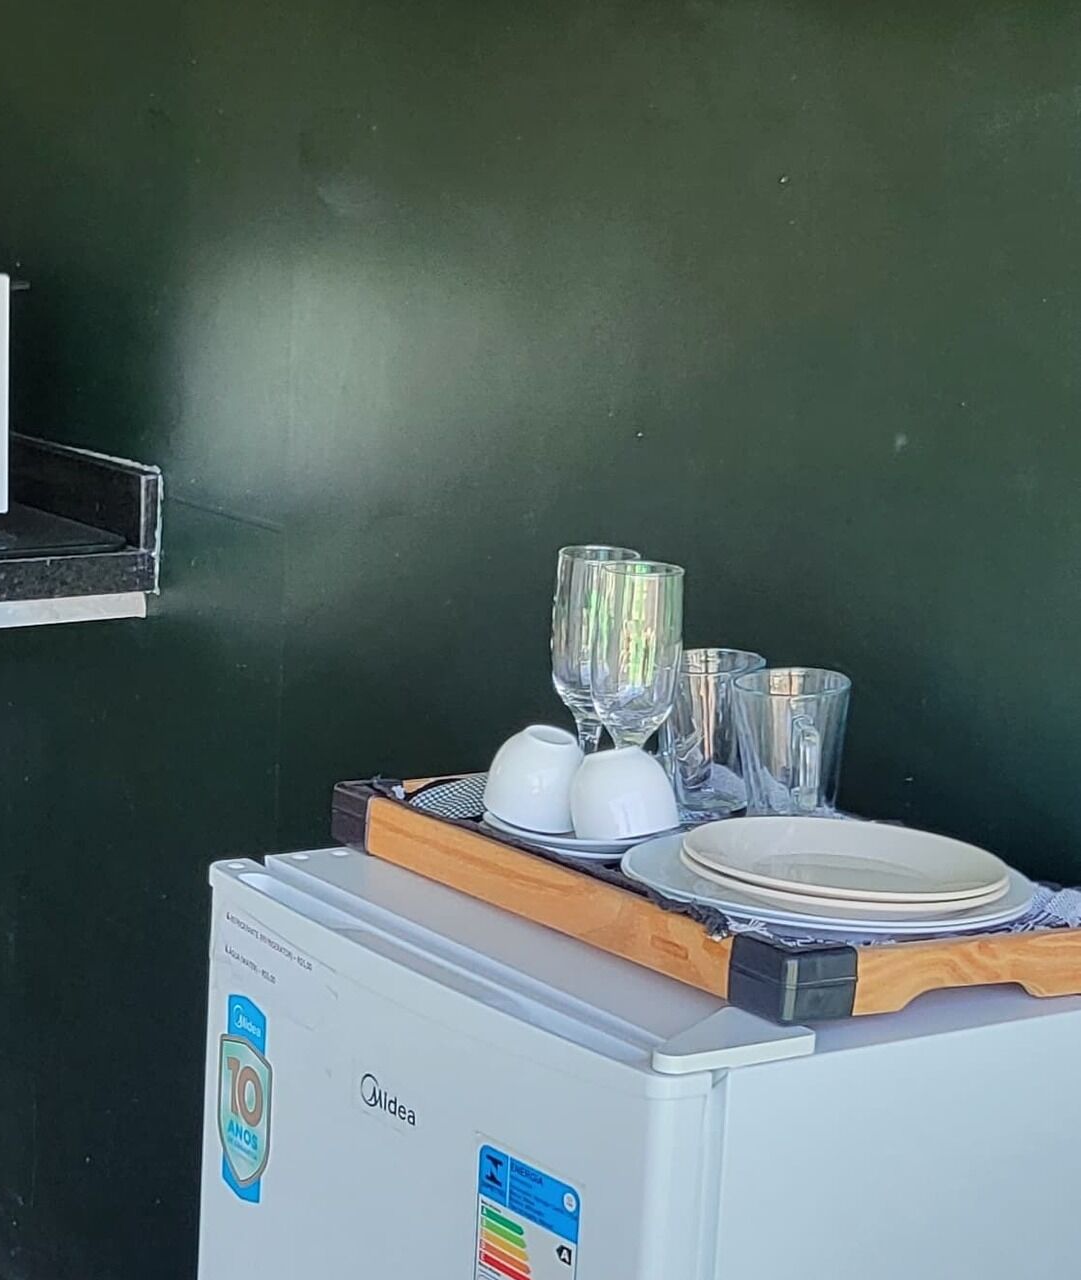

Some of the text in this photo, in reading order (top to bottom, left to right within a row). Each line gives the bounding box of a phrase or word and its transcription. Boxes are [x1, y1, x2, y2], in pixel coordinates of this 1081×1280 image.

[227, 1056, 263, 1127] 10
[360, 1073, 416, 1126] Midea
[228, 1120, 258, 1151] ANOS
